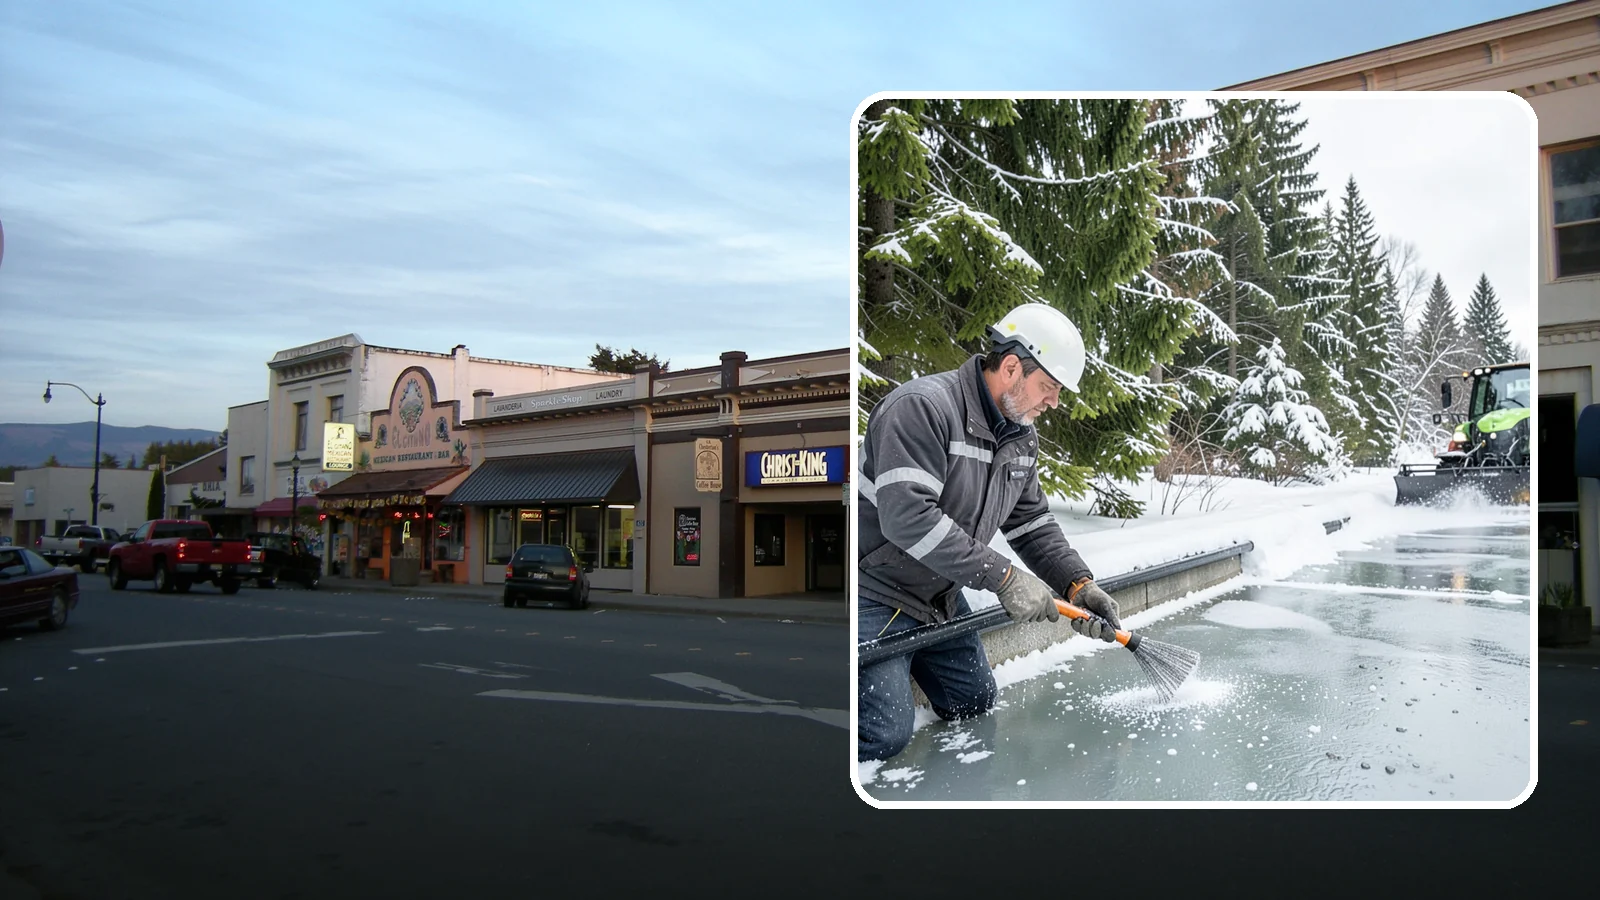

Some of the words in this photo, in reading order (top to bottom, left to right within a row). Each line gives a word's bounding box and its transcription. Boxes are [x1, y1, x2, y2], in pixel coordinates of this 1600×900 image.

[530, 396, 561, 408] Sparkle
[561, 394, 583, 405] Shop
[595, 389, 624, 400] LAUNDRY
[493, 402, 523, 413] LAVANDERIA
[373, 454, 396, 464] MEXICAN
[397, 451, 434, 461] RESTAURANT
[438, 450, 450, 459] BAR
[760, 452, 798, 478] CHRIST
[799, 450, 828, 476] KING
